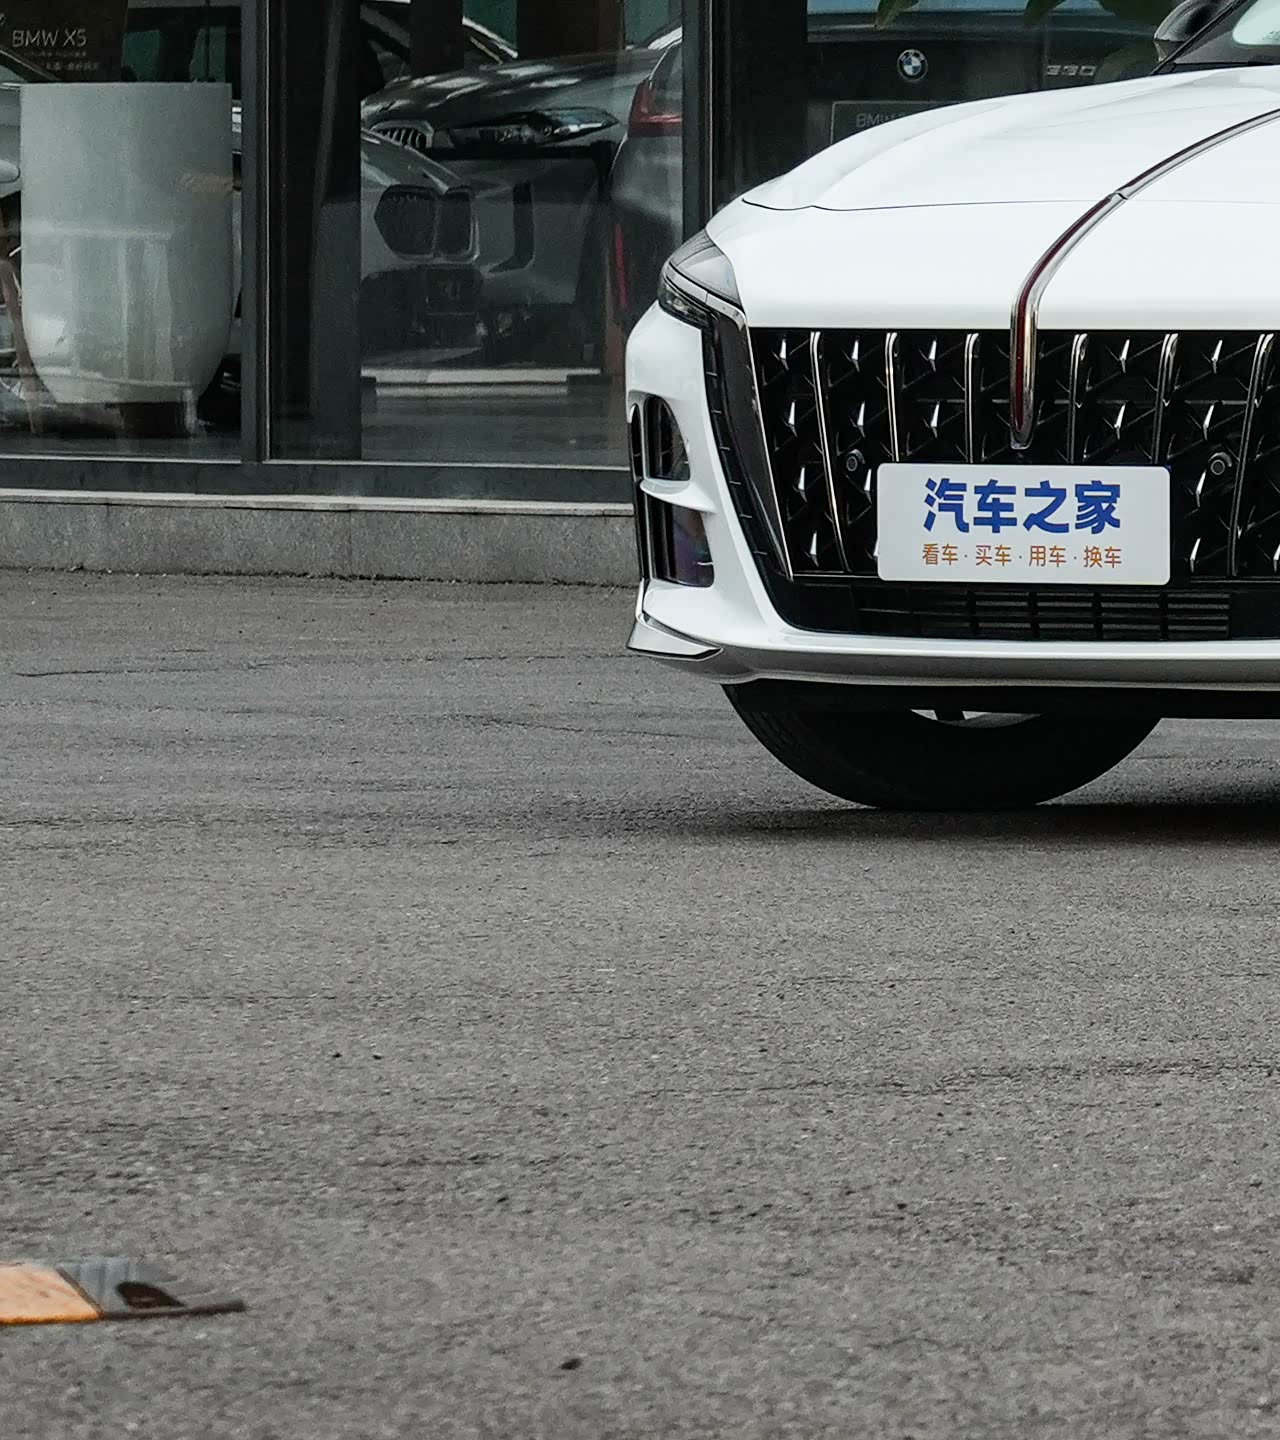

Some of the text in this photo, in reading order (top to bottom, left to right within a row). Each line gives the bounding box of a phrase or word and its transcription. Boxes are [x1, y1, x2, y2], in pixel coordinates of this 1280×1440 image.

[12, 28, 87, 47] BMW X5
[923, 478, 1121, 534] 汽车之家
